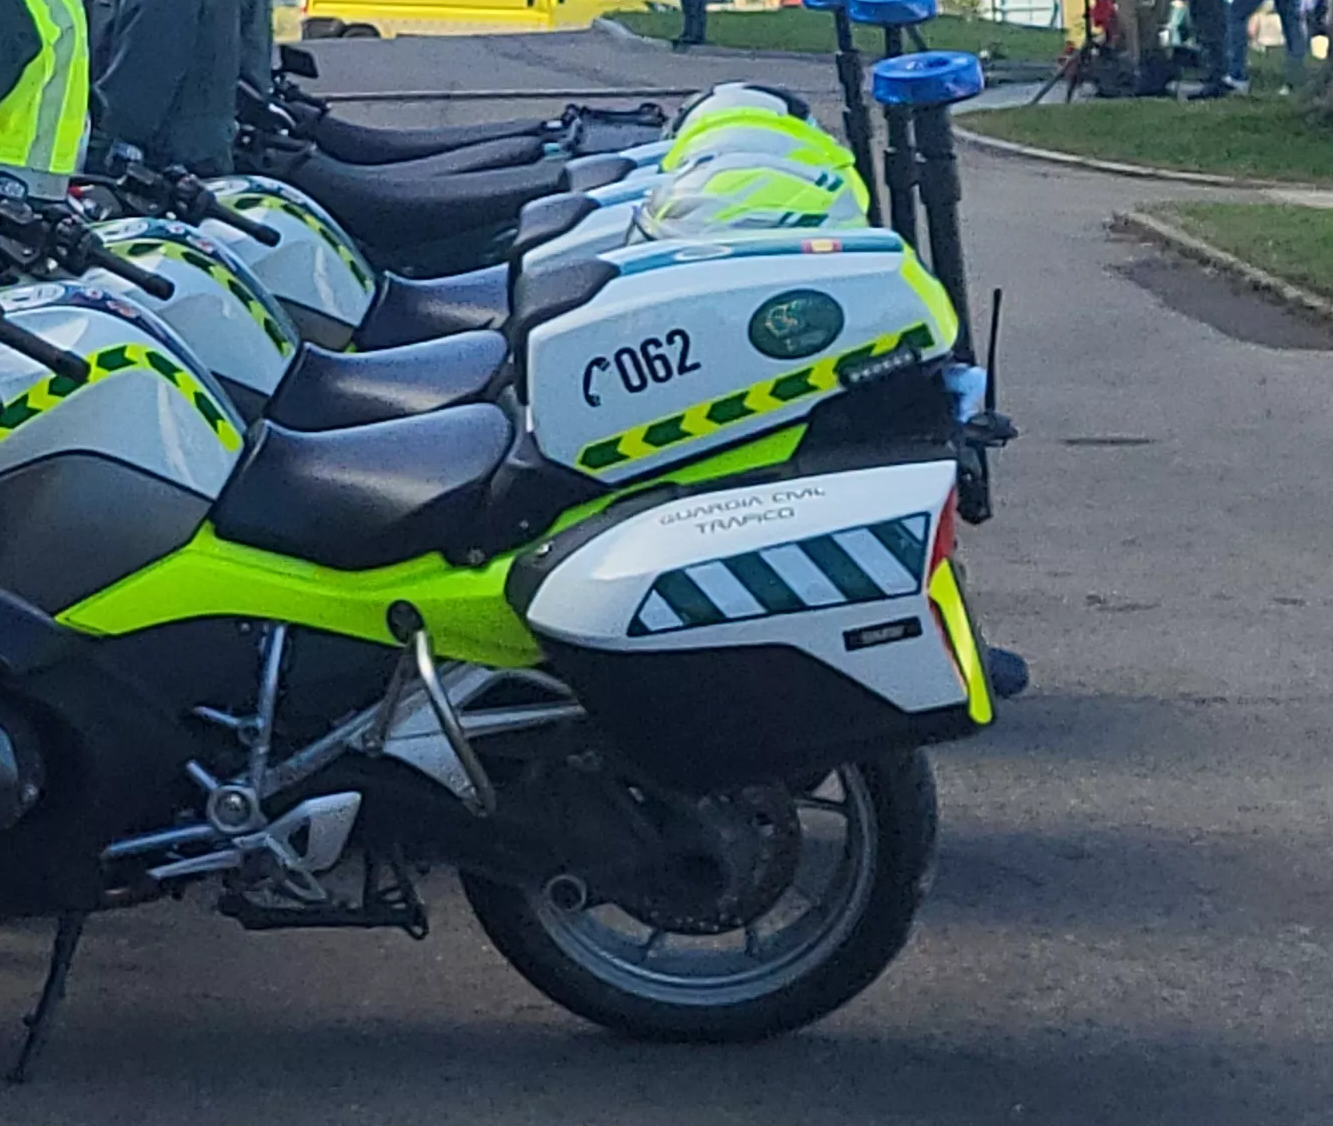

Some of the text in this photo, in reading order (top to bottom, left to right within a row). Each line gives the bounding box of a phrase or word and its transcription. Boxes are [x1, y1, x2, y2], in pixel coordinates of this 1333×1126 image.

[614, 328, 701, 394] 062
[659, 486, 826, 527] GUARDIA CIVIL
[695, 506, 796, 535] TRAFICO
